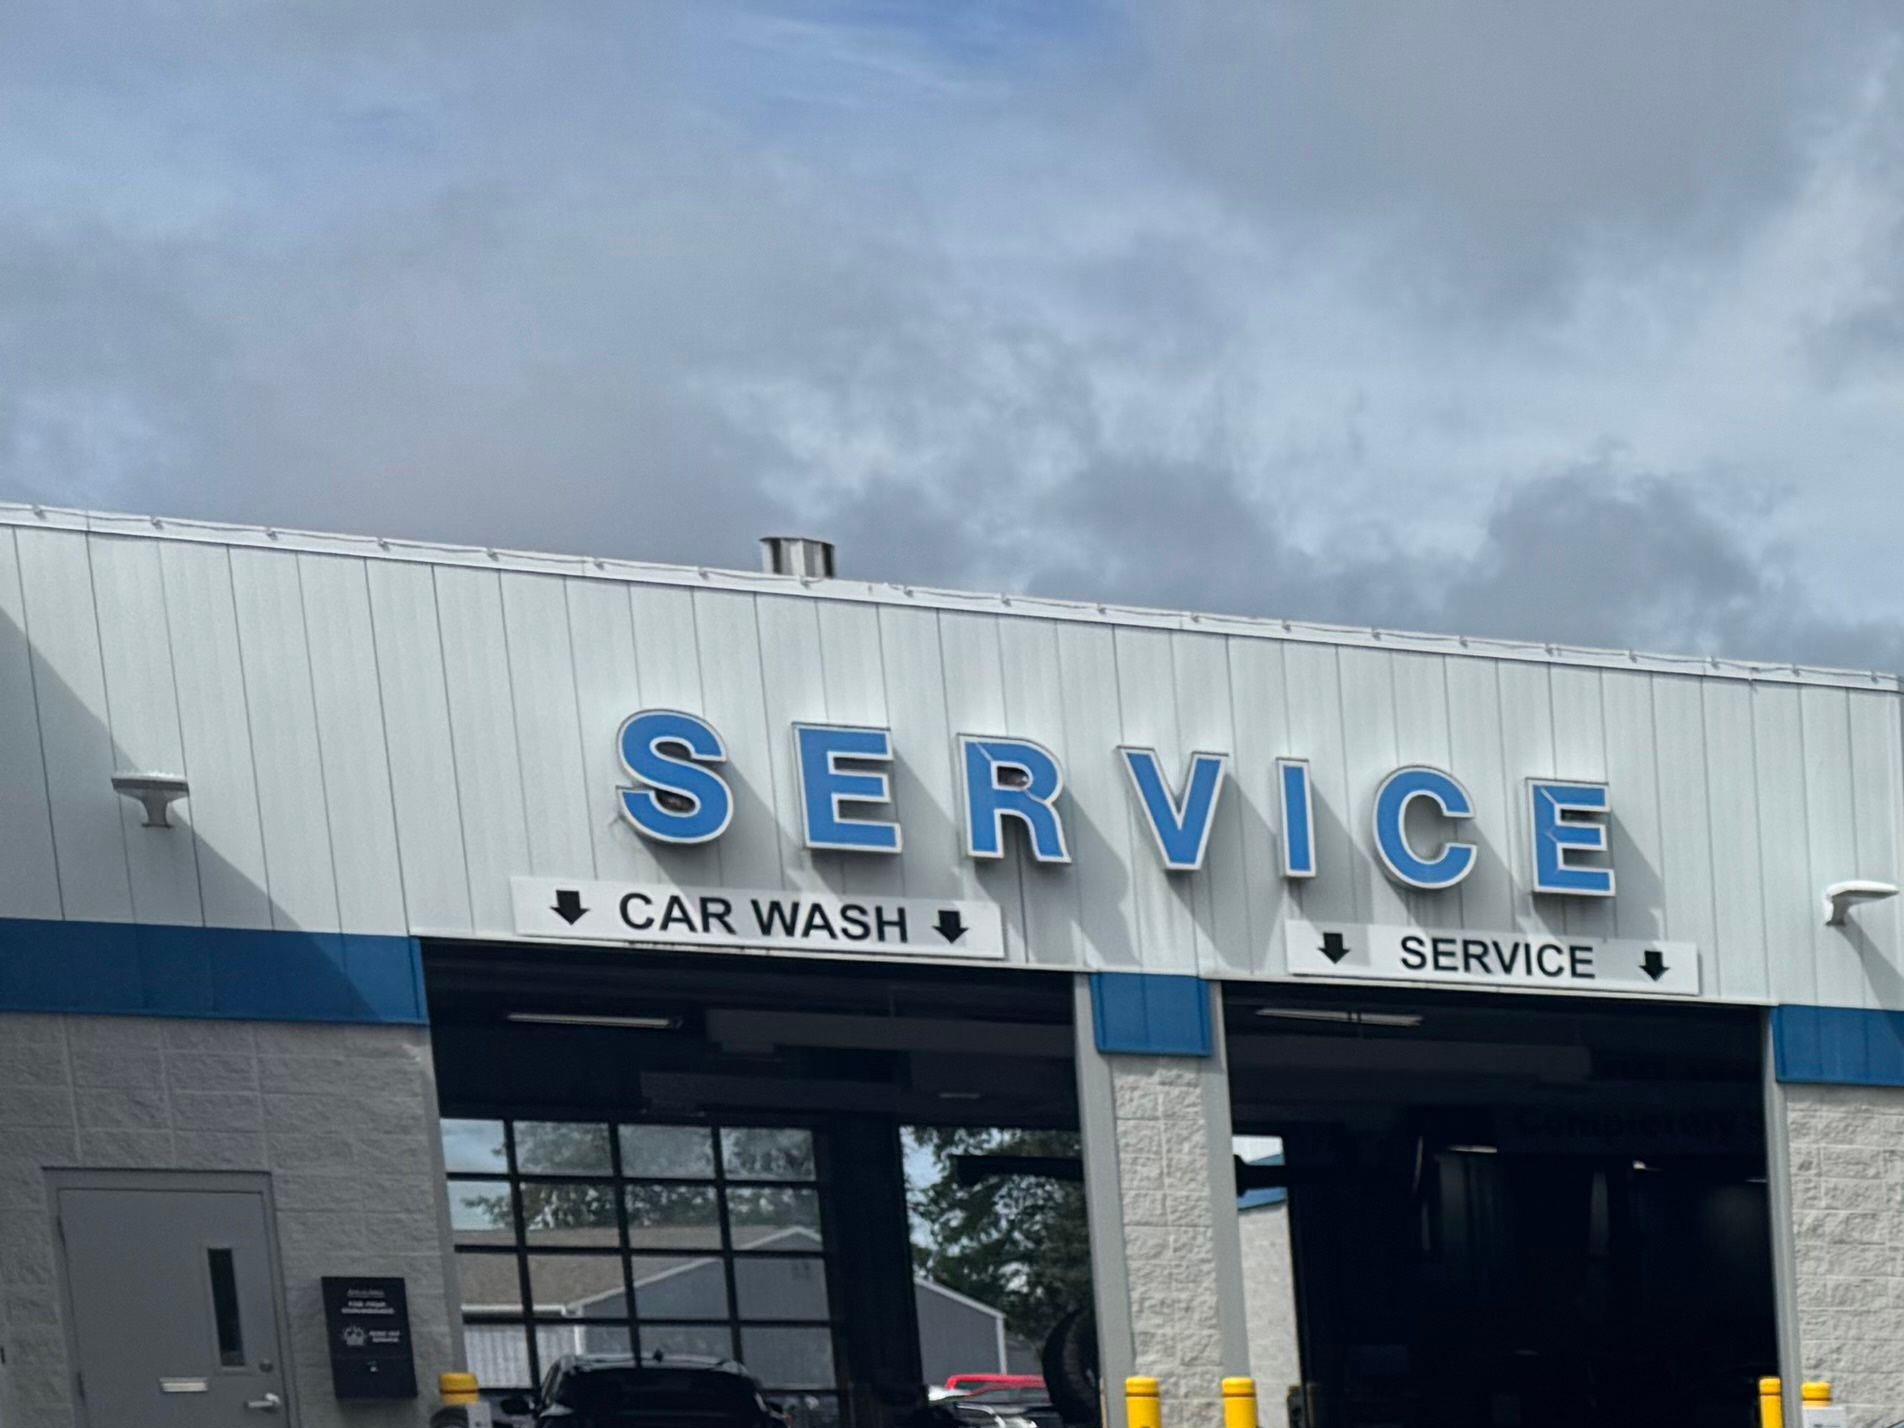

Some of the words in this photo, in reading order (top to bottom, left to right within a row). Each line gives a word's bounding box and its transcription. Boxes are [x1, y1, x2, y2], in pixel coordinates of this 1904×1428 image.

[615, 708, 1616, 897] SERVICE
[619, 892, 737, 935] CAR
[751, 899, 908, 943] WASH
[1400, 936, 1595, 979] SERVICE
